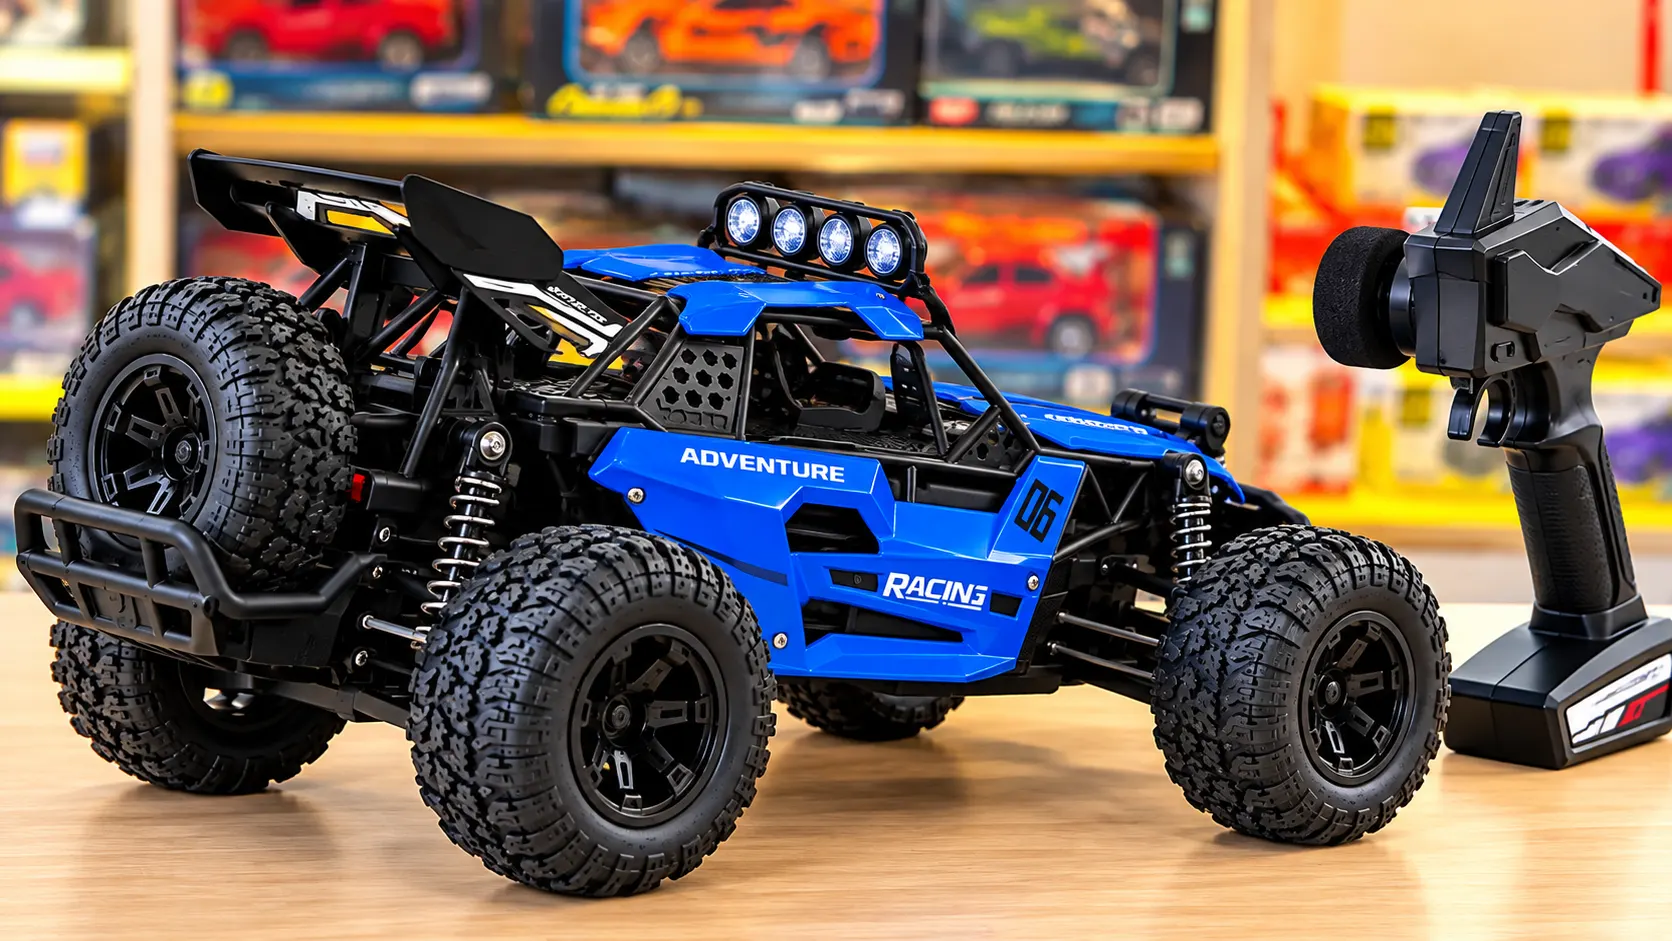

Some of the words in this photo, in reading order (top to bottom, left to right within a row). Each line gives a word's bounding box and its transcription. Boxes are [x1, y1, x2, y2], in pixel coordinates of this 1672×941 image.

[680, 447, 845, 483] ADVENTURE
[1014, 479, 1065, 543] 06
[883, 572, 988, 610] RACING
